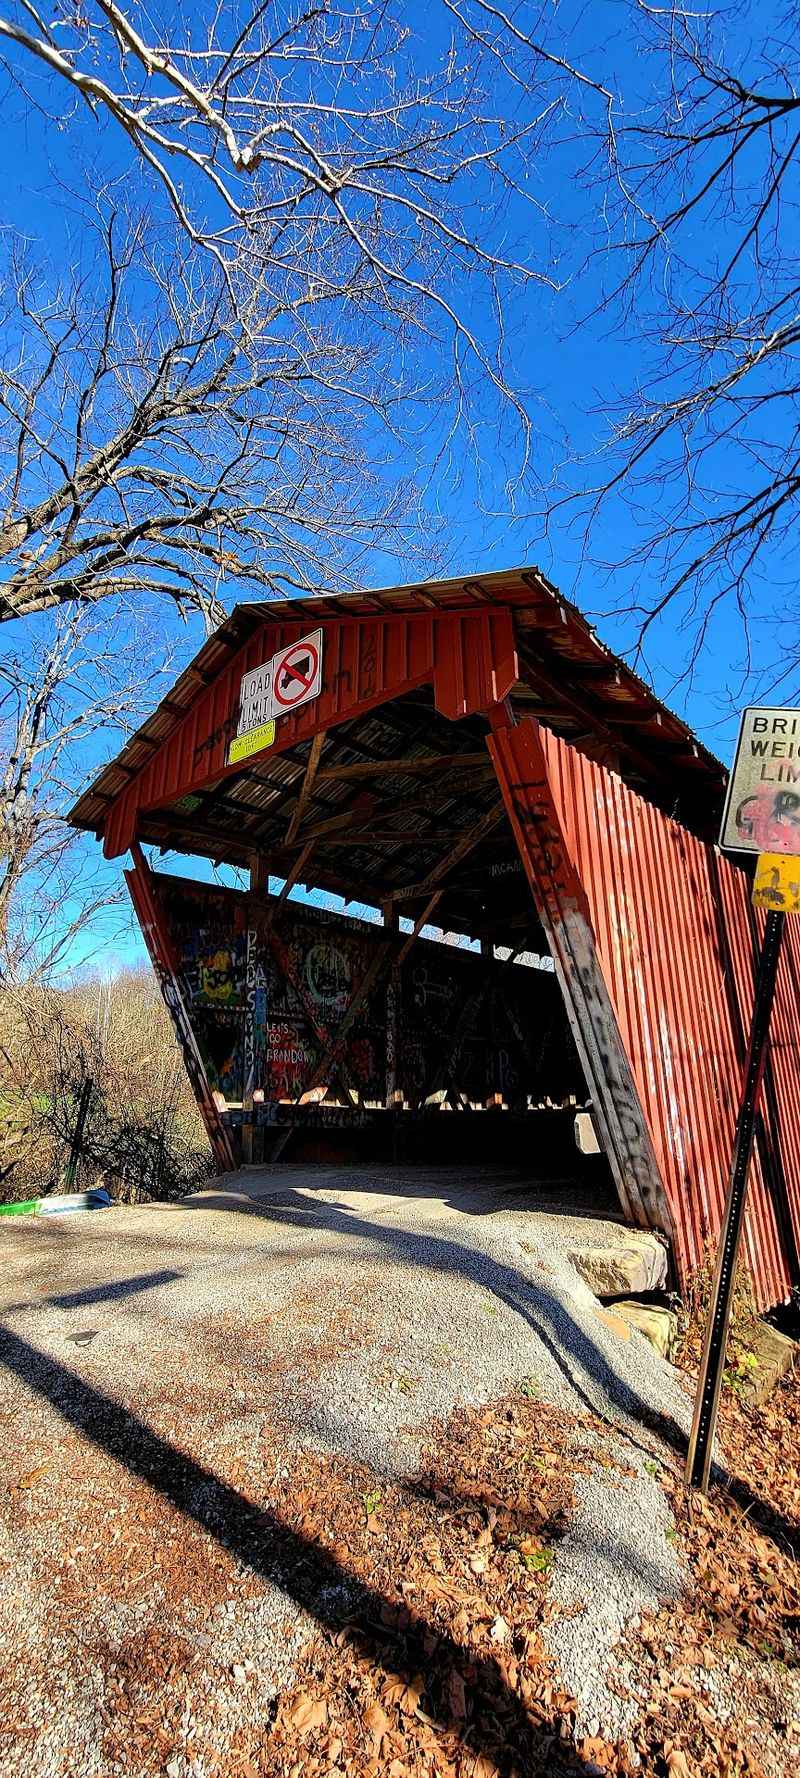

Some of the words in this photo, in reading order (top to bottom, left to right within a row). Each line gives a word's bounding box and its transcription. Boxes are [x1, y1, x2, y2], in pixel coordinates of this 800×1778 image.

[243, 672, 271, 700] LOAD
[241, 696, 269, 724] LIMIT
[752, 717, 796, 735] BRI
[750, 739, 800, 758] WEI
